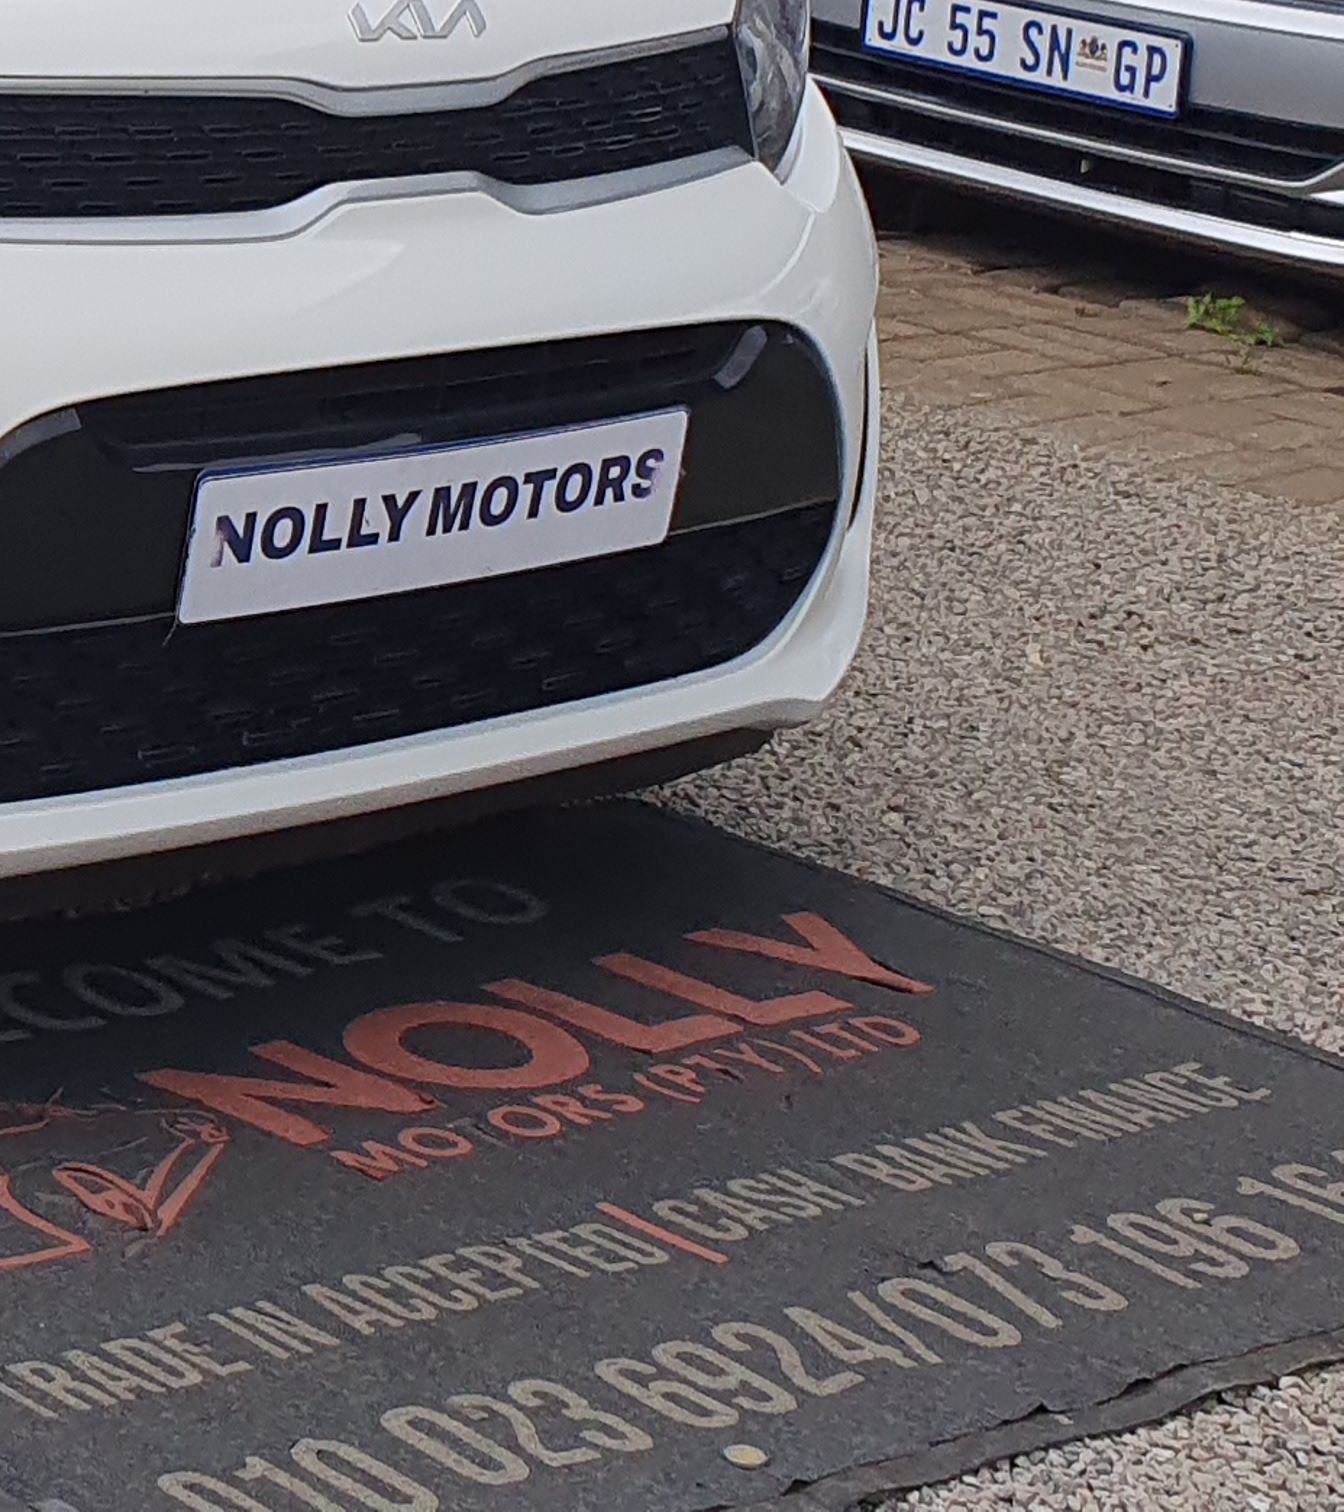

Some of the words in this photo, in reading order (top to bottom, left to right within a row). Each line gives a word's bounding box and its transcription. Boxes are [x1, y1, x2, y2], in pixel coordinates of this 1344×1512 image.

[947, 4, 999, 63] 55
[1019, 19, 1074, 82] SN
[1113, 39, 1168, 101] GP
[210, 488, 424, 569] NOLLY
[424, 447, 666, 539] MOTORS
[353, 875, 550, 943] TO
[135, 910, 935, 1145] NOLLY
[330, 1083, 646, 1181] MOTORS
[207, 1299, 342, 1360] IN
[301, 1221, 671, 1335] ACCEPTED
[651, 1167, 867, 1242] CASH
[831, 1120, 1050, 1193] BANK
[990, 1061, 1273, 1149] FINANCE
[380, 1378, 655, 1486] 023
[1069, 1196, 1302, 1289] 196
[1236, 1148, 1344, 1225] 16
